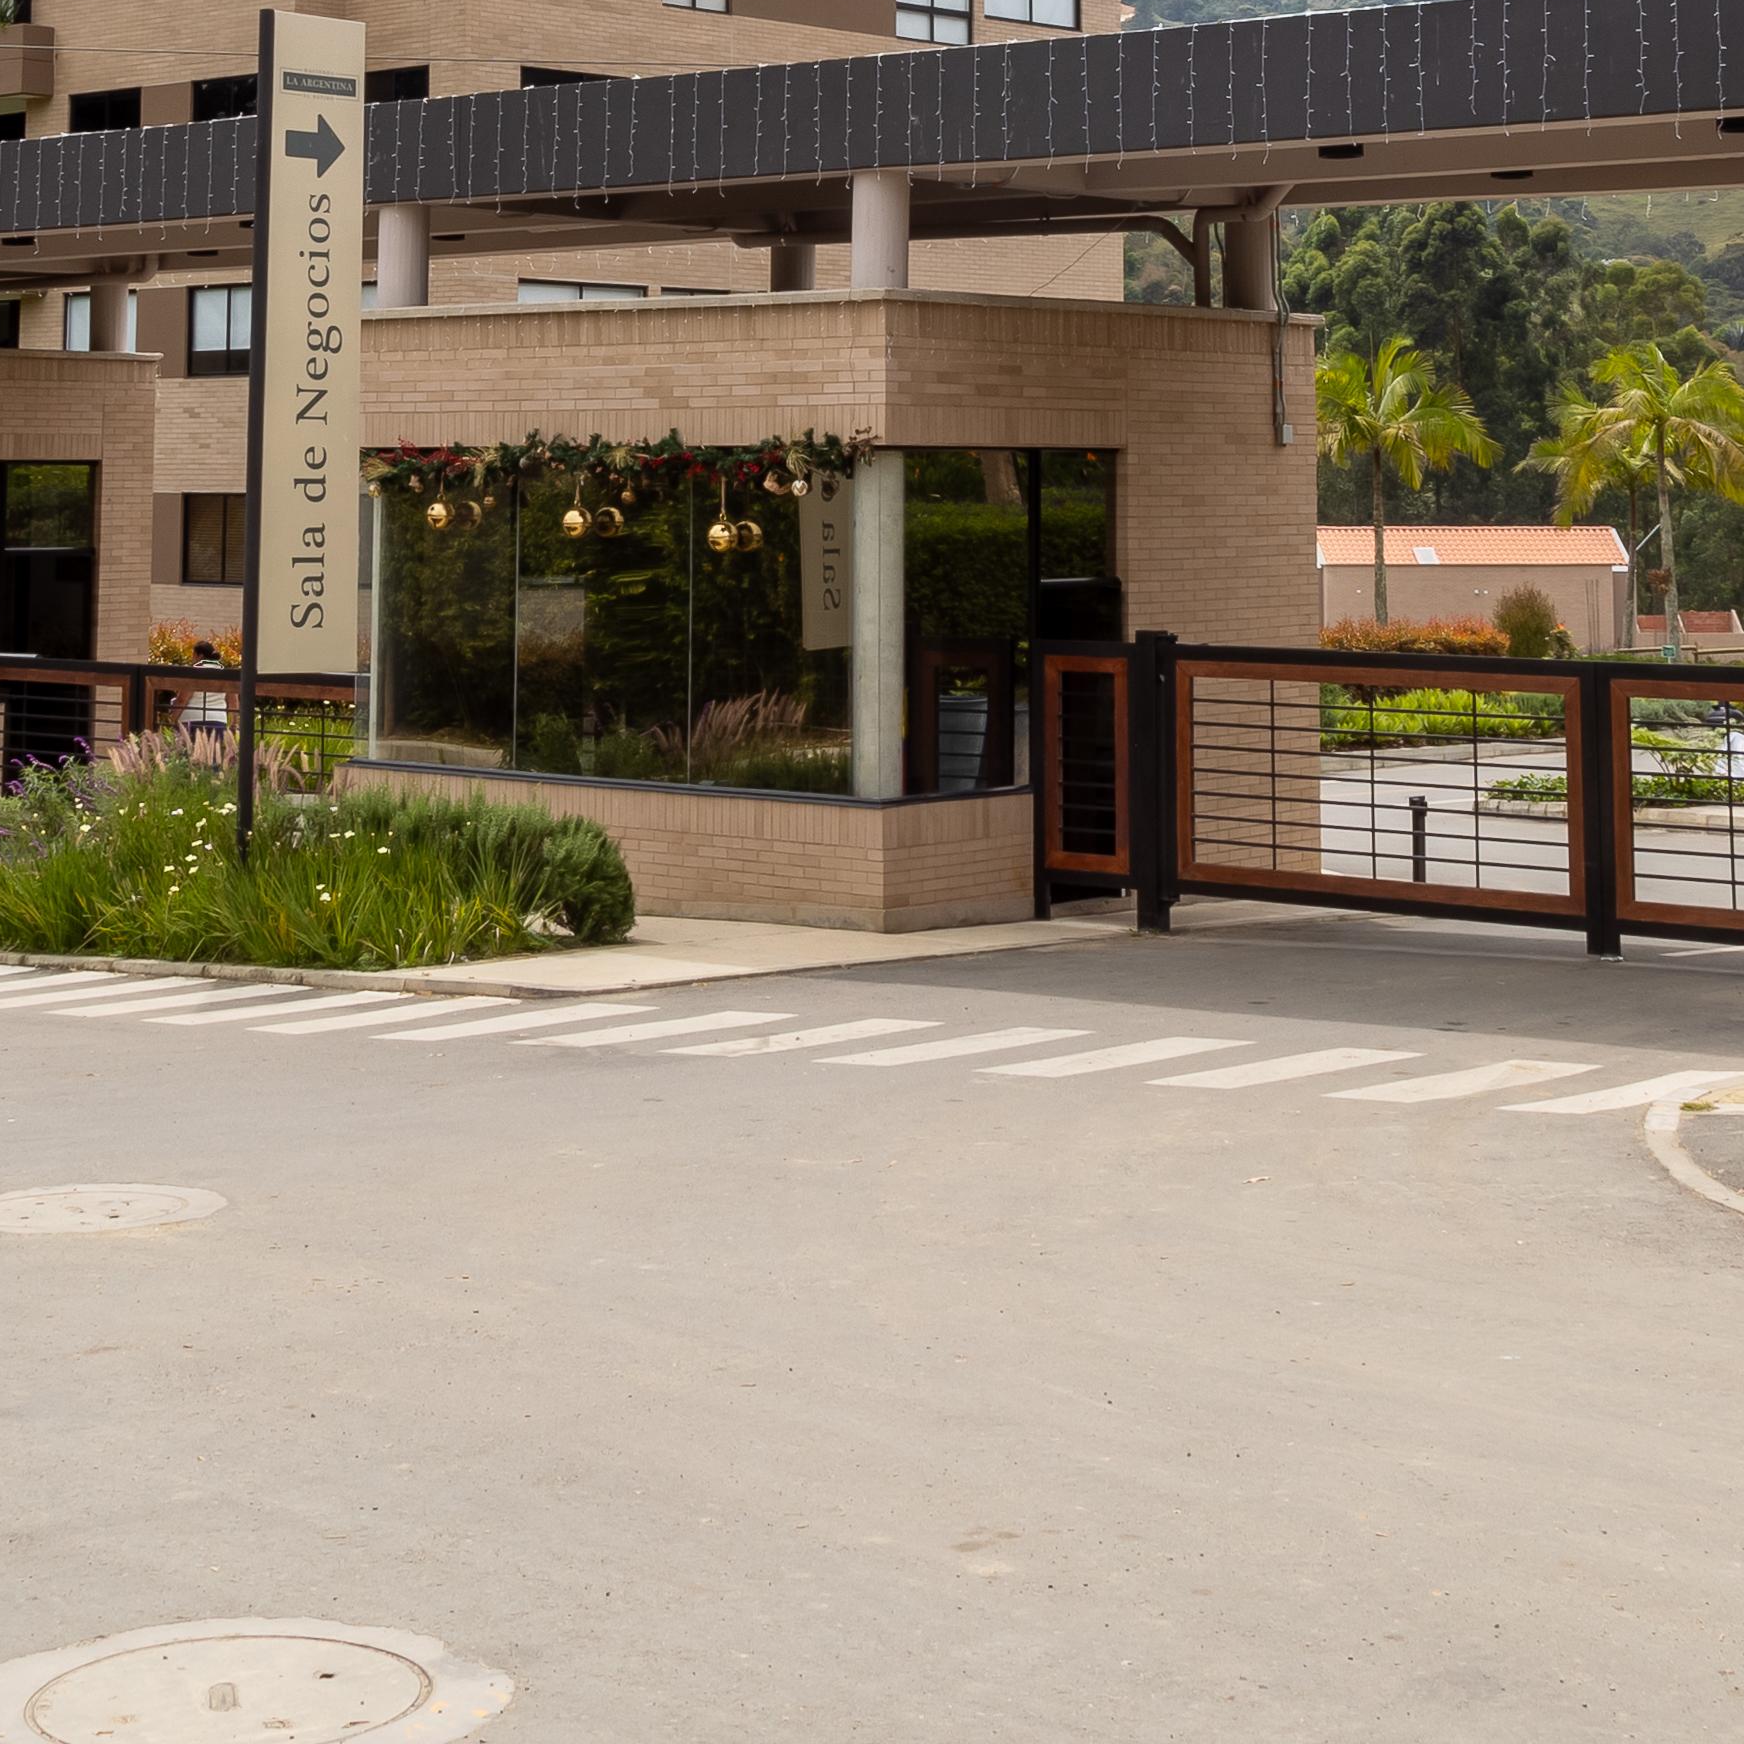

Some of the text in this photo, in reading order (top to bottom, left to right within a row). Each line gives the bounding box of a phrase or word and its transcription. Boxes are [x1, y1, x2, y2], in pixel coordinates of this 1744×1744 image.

[286, 76, 353, 92] LA ARGENTINA
[290, 193, 343, 629] Sala de Negocios
